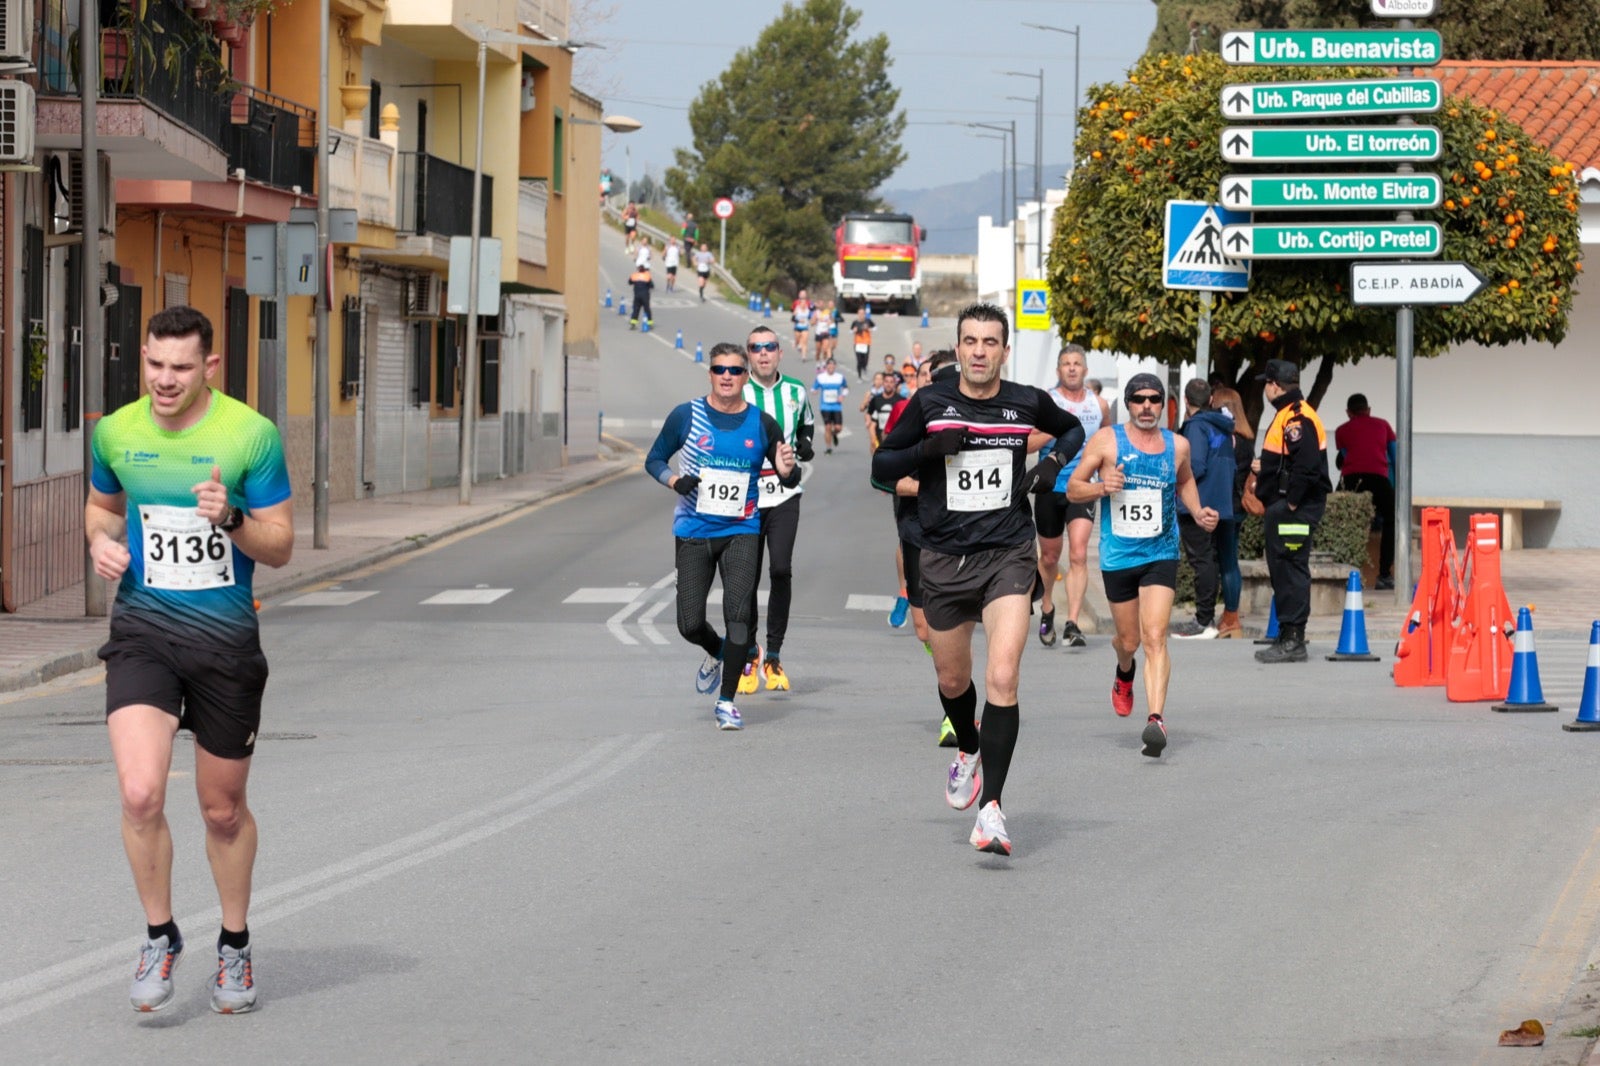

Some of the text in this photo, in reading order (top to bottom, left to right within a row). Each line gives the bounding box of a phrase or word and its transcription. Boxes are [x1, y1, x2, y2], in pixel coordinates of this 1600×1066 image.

[1388, 0, 1428, 10] Albolote
[1259, 38, 1436, 60] Urb. Buenavista
[1257, 86, 1431, 110] Urb. Parque del Cubillas
[1305, 133, 1430, 152] Urb. El torreón
[1282, 181, 1430, 200] Urb. Monte Elvira
[1277, 229, 1431, 251] Urb. Cortijo Pretel
[1357, 275, 1464, 290] C.E.I.P. ABADÍA
[958, 467, 1002, 491] 814
[707, 483, 740, 501] 192
[1119, 504, 1153, 521] 153
[149, 532, 226, 564] 3136
